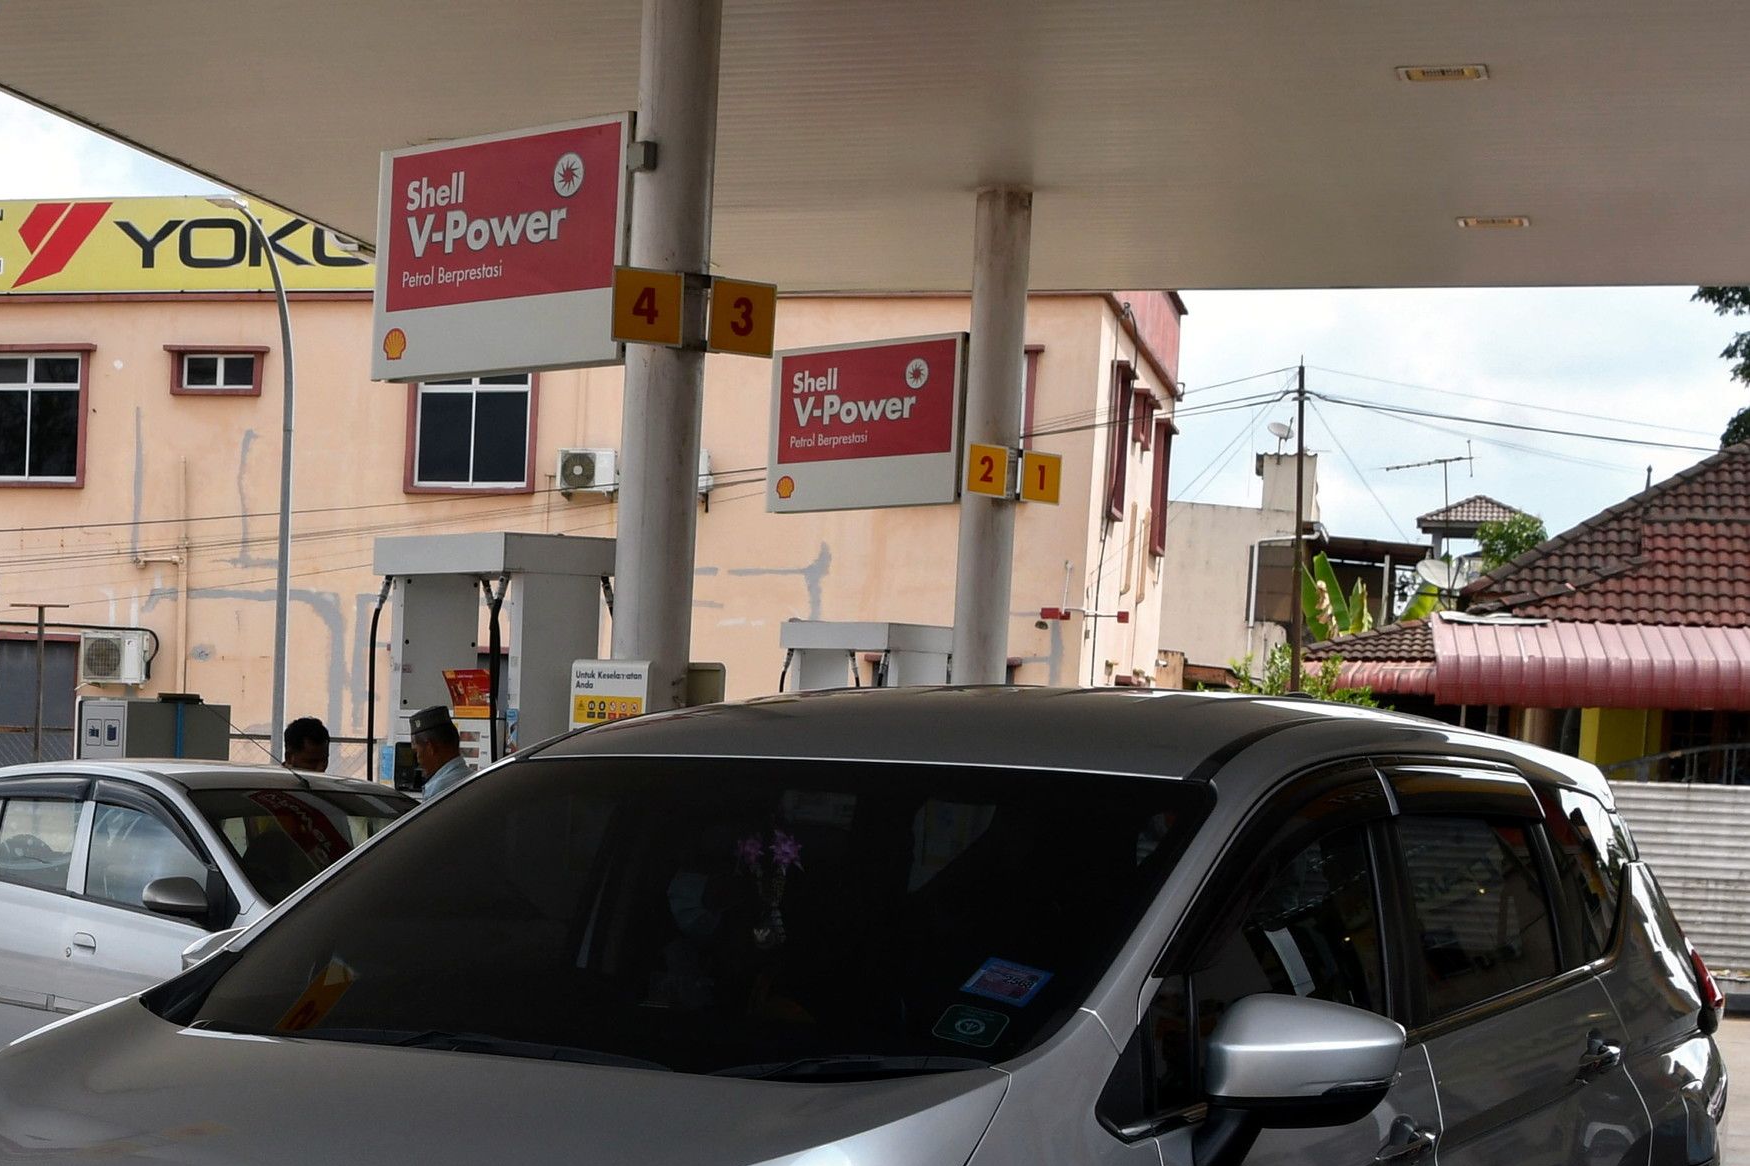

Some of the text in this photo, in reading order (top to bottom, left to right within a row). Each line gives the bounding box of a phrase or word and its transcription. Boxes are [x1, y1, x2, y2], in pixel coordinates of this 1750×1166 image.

[406, 171, 466, 211] Shell
[407, 207, 568, 258] V-Power
[402, 259, 503, 288] Petrol Berprestasi
[632, 287, 659, 325] 4
[730, 296, 754, 337] 3
[792, 368, 838, 394] Shell
[793, 394, 917, 427] V-Power
[790, 430, 868, 449] Petrol Berprestasi
[979, 455, 994, 483] 2
[1038, 464, 1045, 491] 1
[575, 670, 596, 679] Untuk
[575, 680, 594, 689] Anda
